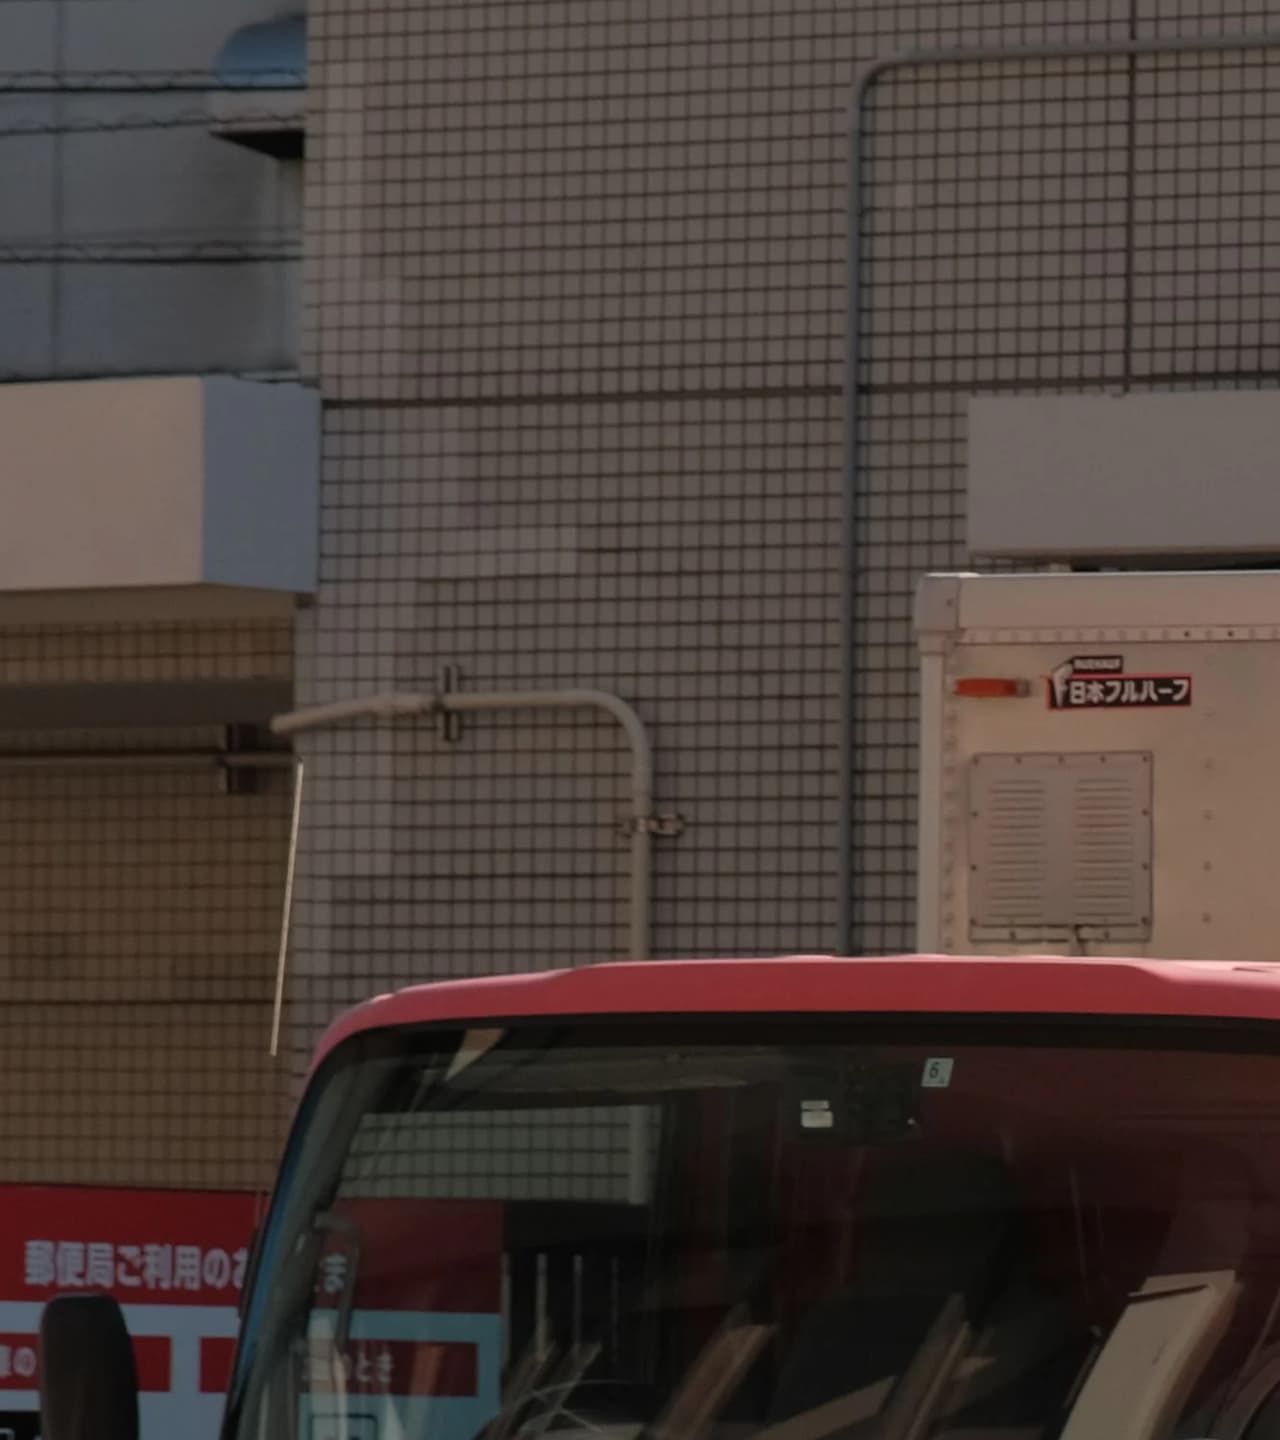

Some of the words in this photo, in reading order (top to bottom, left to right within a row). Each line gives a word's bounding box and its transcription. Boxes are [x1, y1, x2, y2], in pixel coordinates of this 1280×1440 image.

[1069, 680, 1190, 705] 日本フルハーフ
